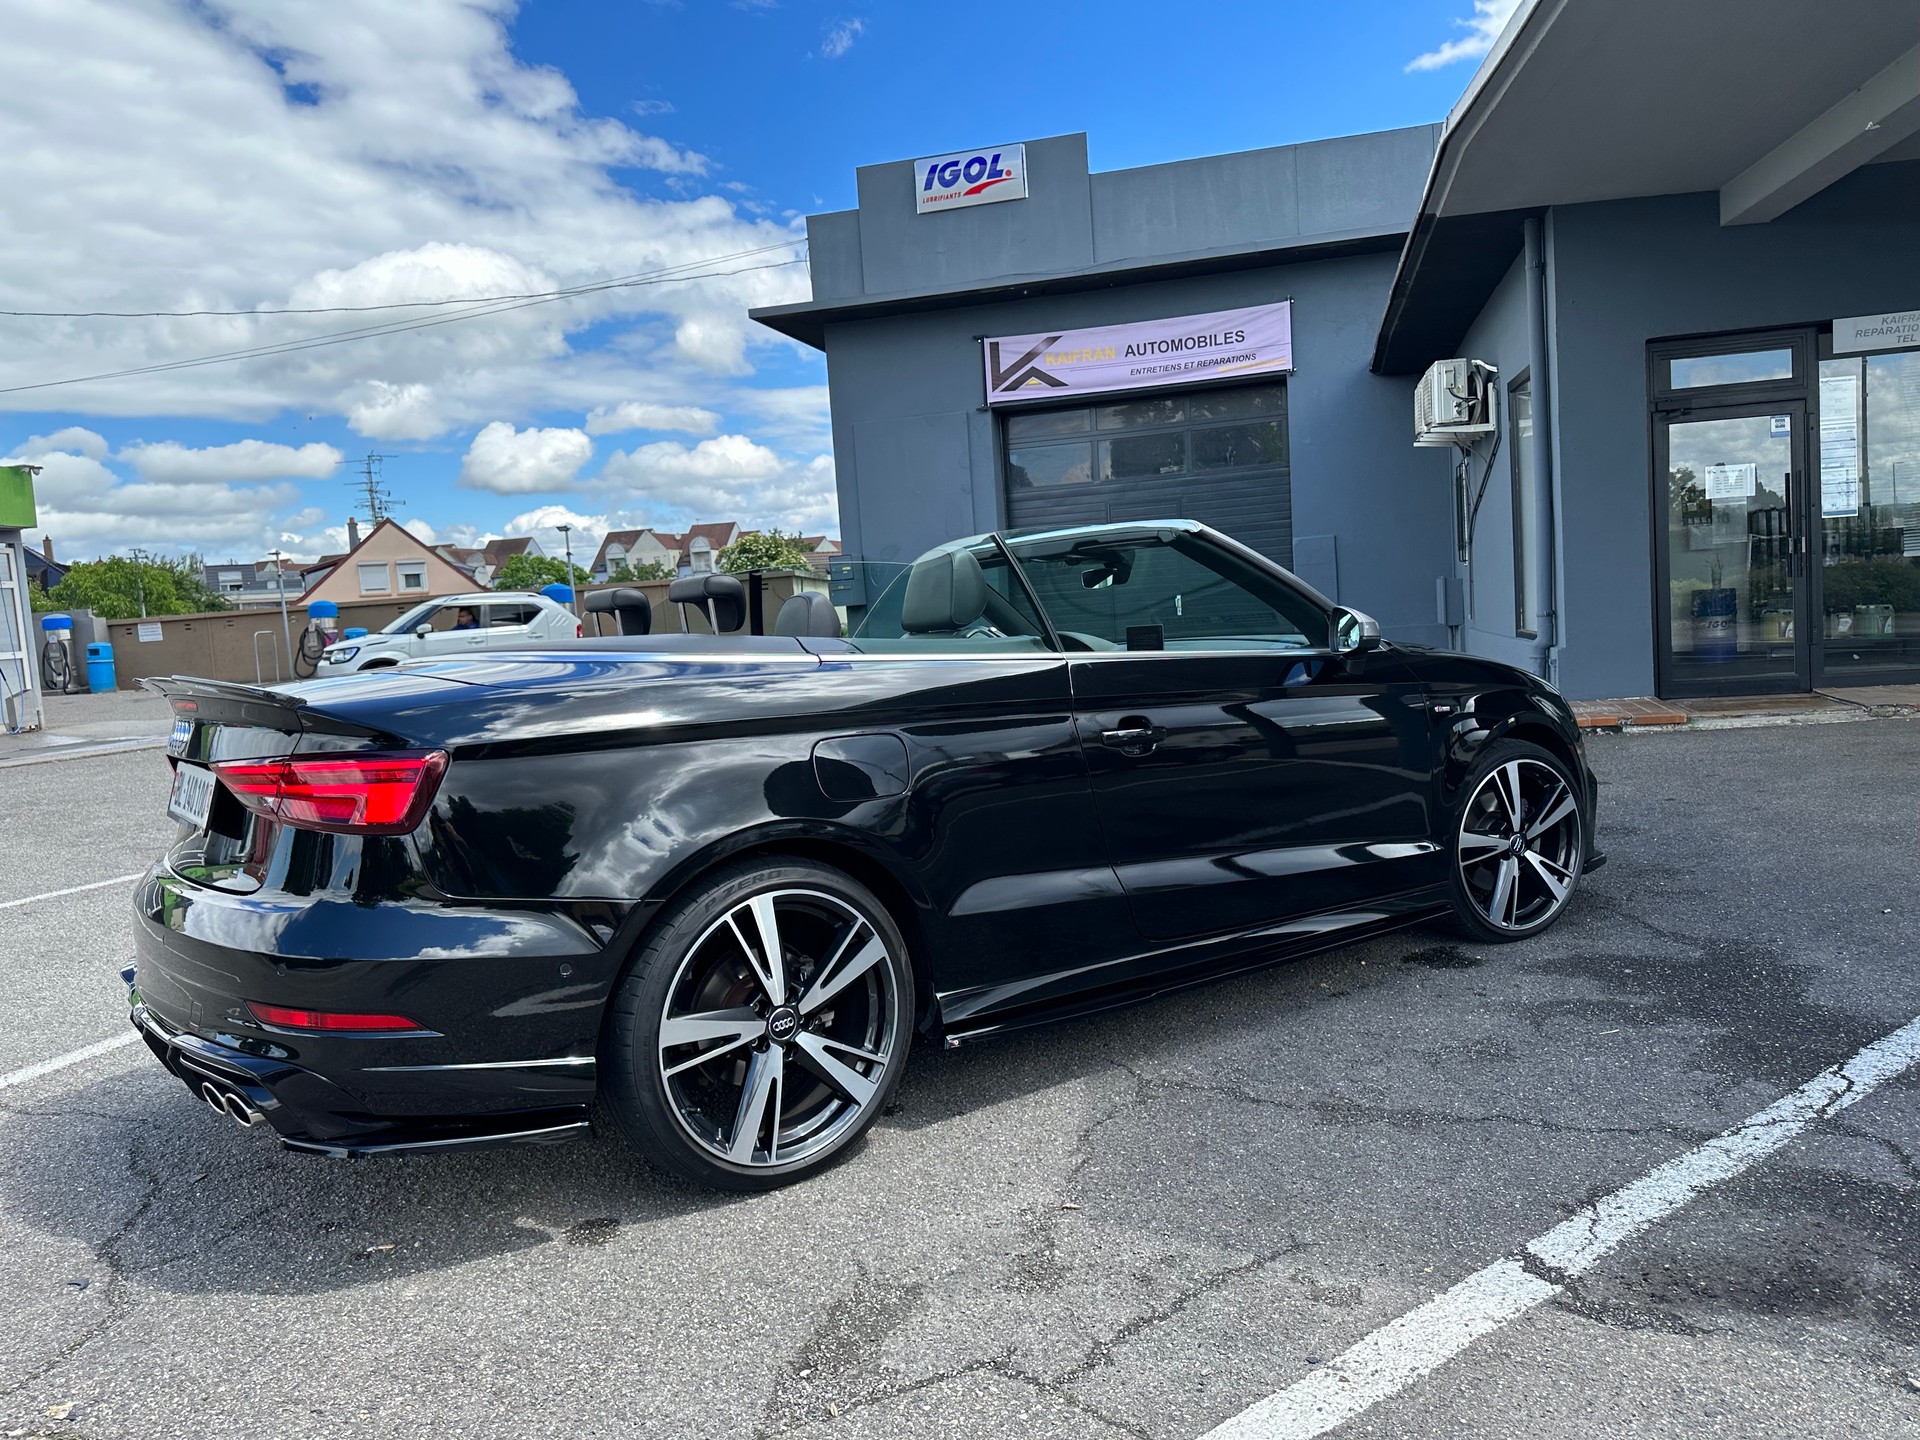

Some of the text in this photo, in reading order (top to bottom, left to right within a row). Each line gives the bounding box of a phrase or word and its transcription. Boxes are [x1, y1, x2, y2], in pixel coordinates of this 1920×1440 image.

[922, 191, 962, 204] LUBRIFIANTS
[1045, 329, 1246, 366] KAIFRAN AUTOMOBILES
[1896, 334, 1917, 344] TEL
[1130, 353, 1257, 376] ENTRETIENS ET REPARATIONS
[722, 869, 783, 900] ZERO
